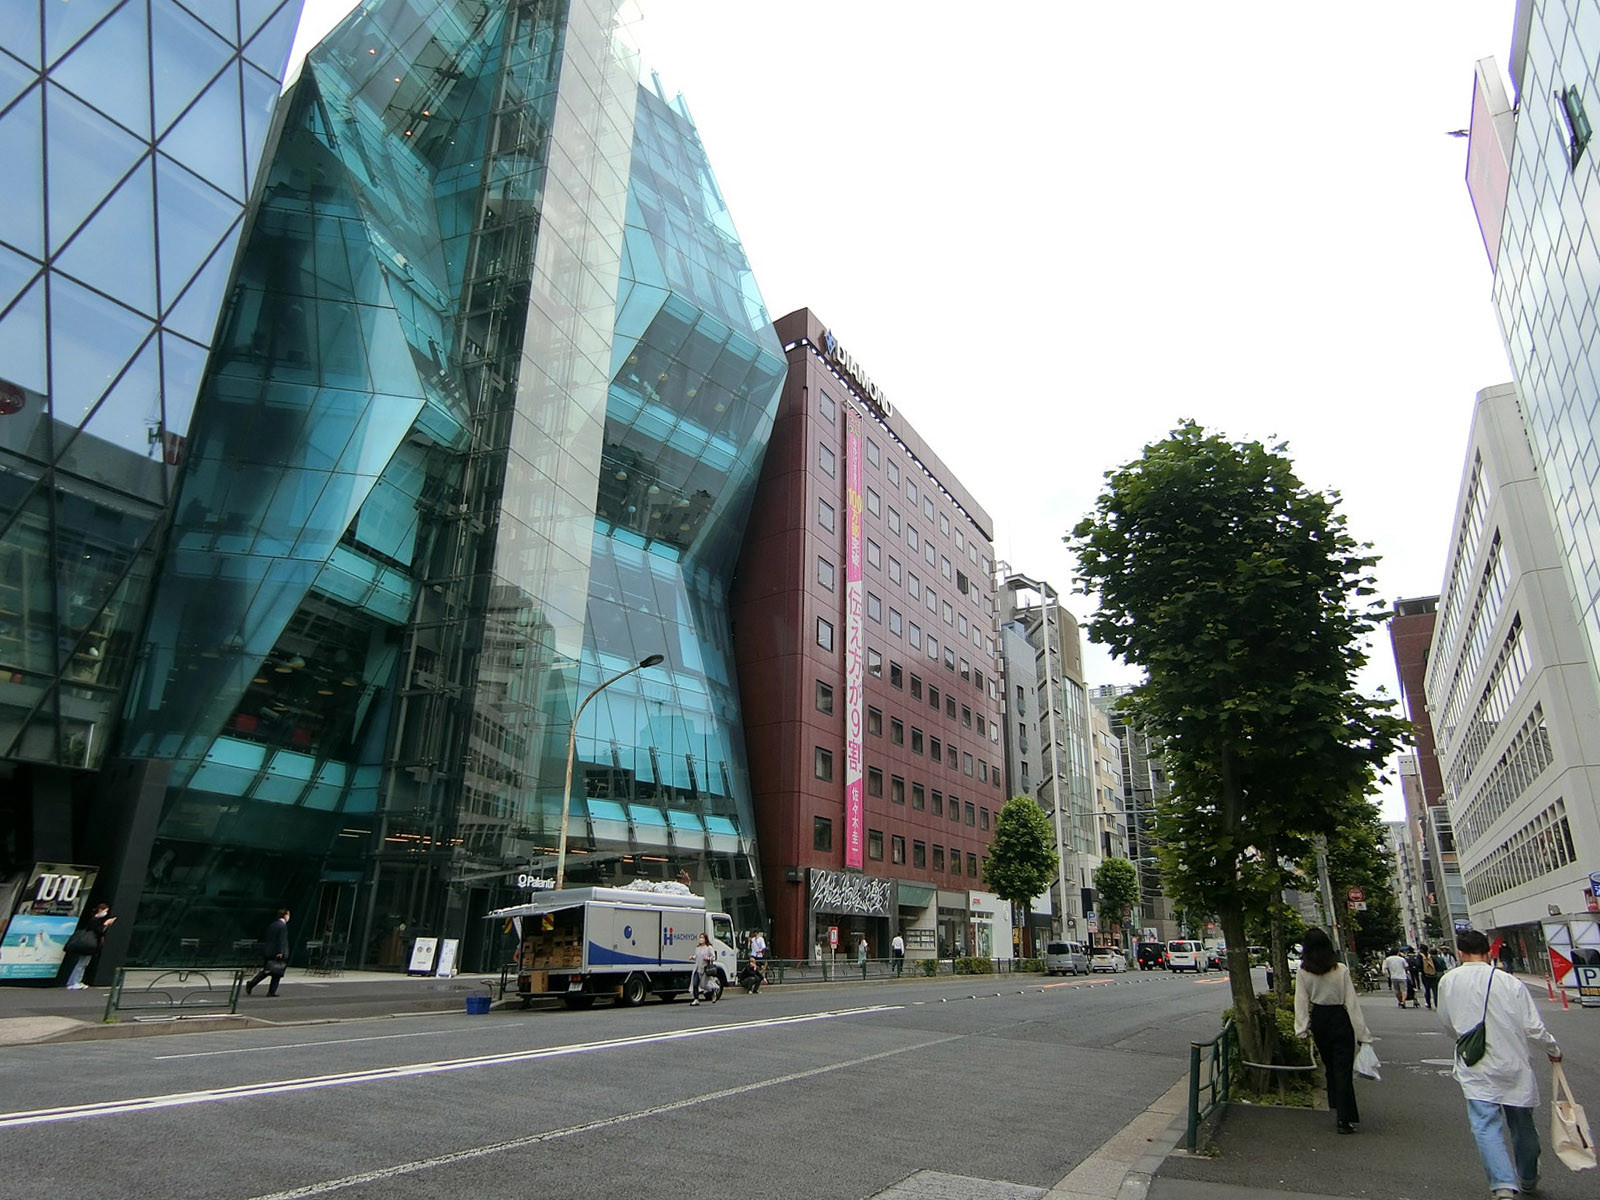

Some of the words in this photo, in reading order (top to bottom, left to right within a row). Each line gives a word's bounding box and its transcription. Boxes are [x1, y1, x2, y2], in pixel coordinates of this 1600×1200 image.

[837, 342, 893, 418] DIAMOND
[851, 787, 859, 852] 佐々木圭一
[526, 875, 556, 889] Palantir
[1583, 968, 1597, 986] P
